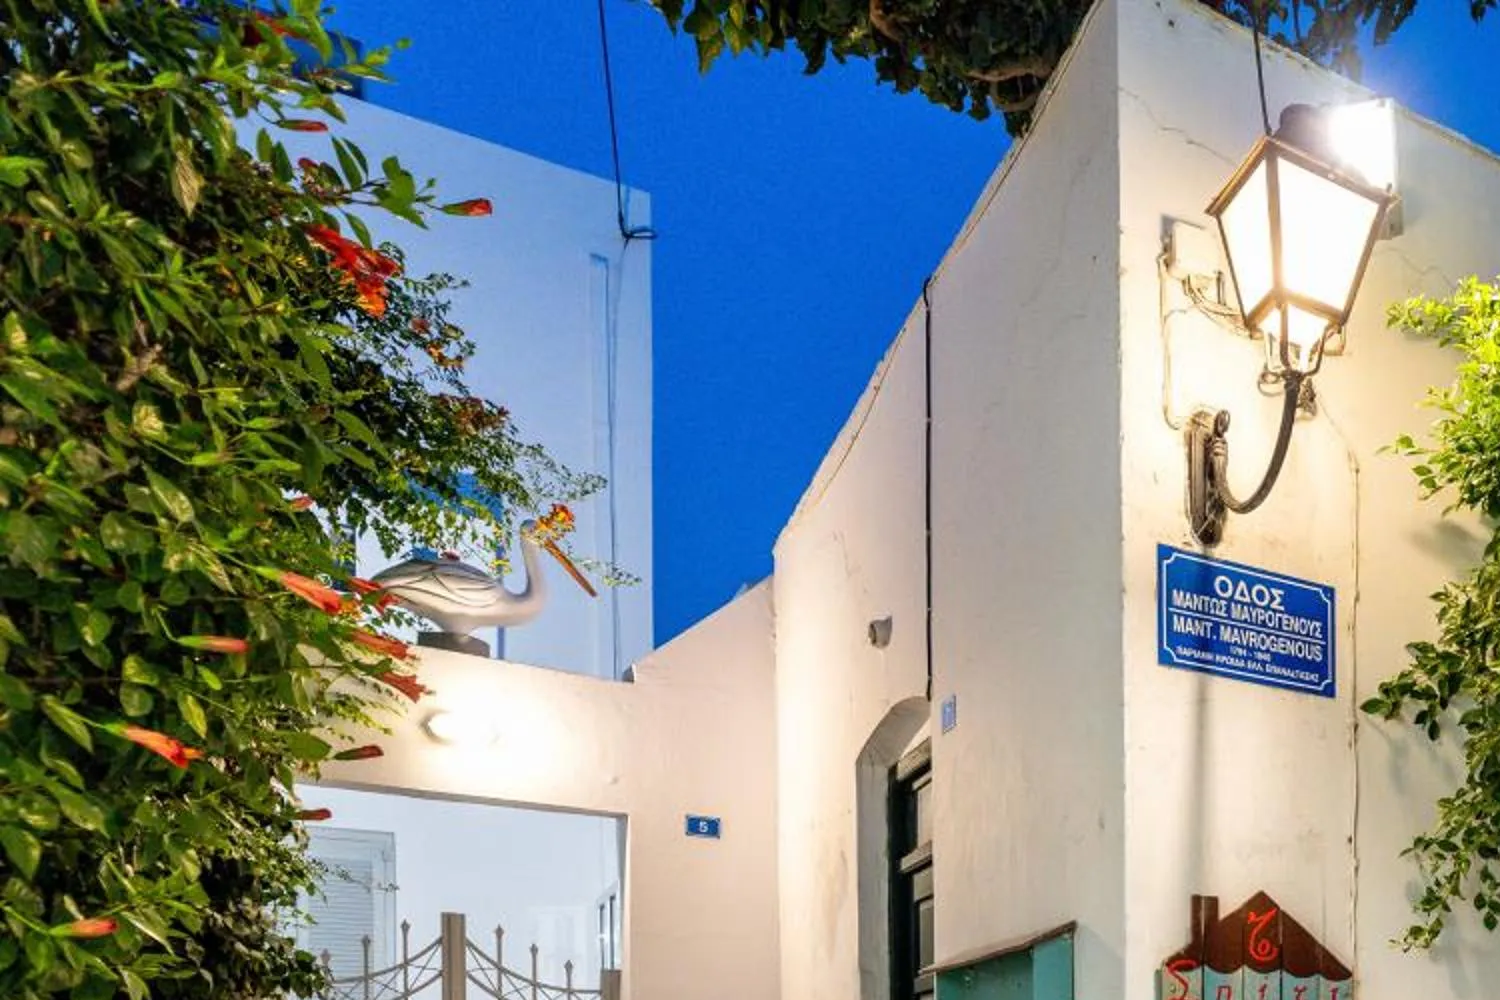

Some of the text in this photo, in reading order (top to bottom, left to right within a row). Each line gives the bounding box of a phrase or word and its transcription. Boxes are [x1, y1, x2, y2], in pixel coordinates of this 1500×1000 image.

[1172, 589, 1323, 639] ΜΑΝΤΩΣ ΜΑΥΡΟΓΕΝΟΥΣ
[1214, 575, 1285, 611] ΟΔΟΣ
[1173, 615, 1217, 640] MANT.
[1219, 625, 1323, 662] MAVROGENOUS
